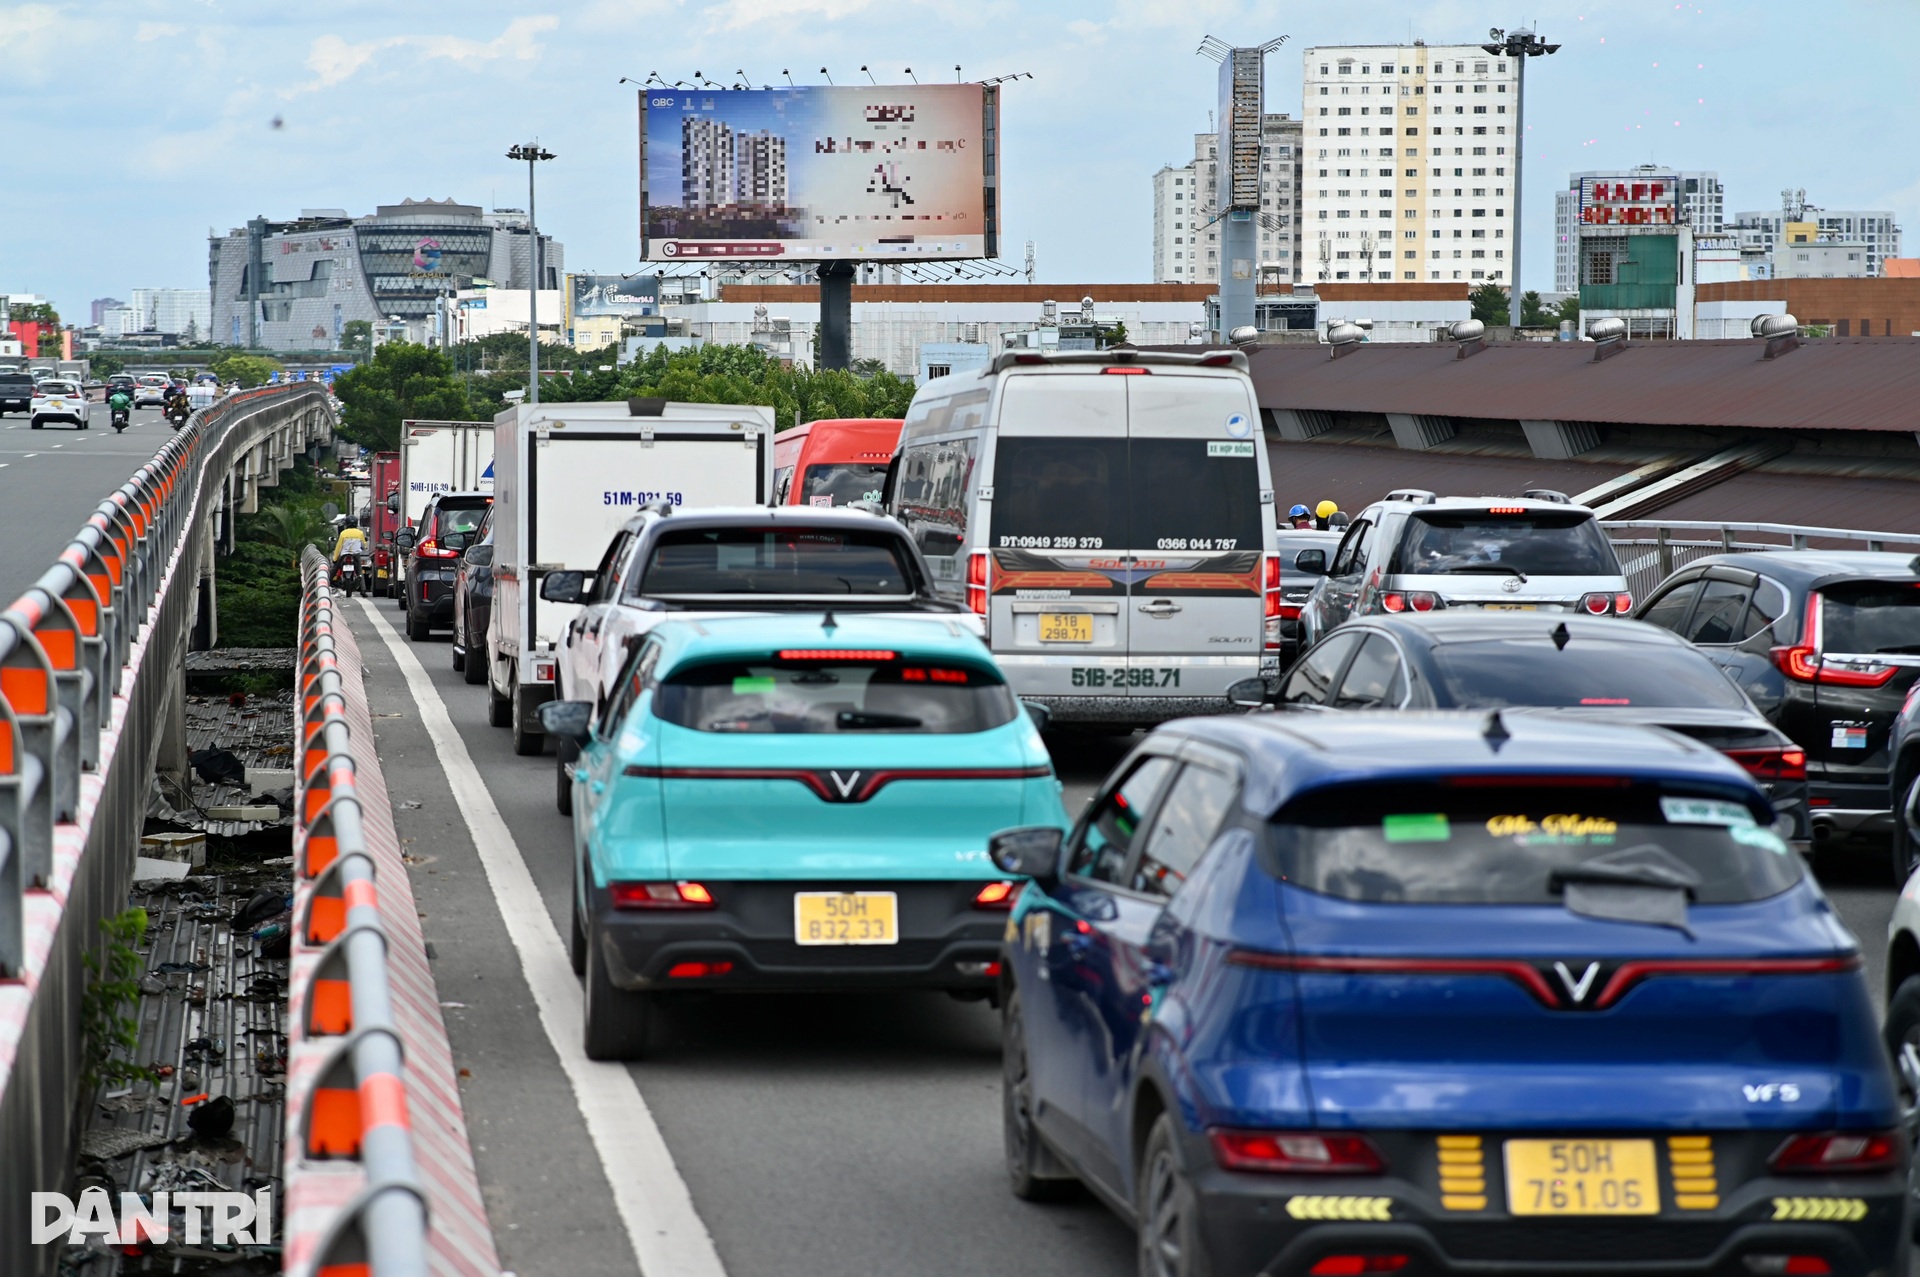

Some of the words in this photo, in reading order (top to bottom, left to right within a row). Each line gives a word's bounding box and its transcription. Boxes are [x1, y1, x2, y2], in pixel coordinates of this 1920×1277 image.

[1698, 238, 1741, 250] KARAOKE
[1053, 537, 1077, 548] 259
[1080, 537, 1103, 549] 379
[1157, 538, 1187, 550] 0366
[1190, 538, 1212, 550] 044
[1215, 538, 1237, 550] 787
[1054, 615, 1078, 627] 51B
[1045, 628, 1087, 640] 298.71
[1071, 667, 1181, 688] 51B-298.71
[825, 896, 868, 918] 50H
[808, 918, 886, 940] 832.33
[1549, 1143, 1614, 1175] 50H
[1526, 1178, 1643, 1209] 761.06
